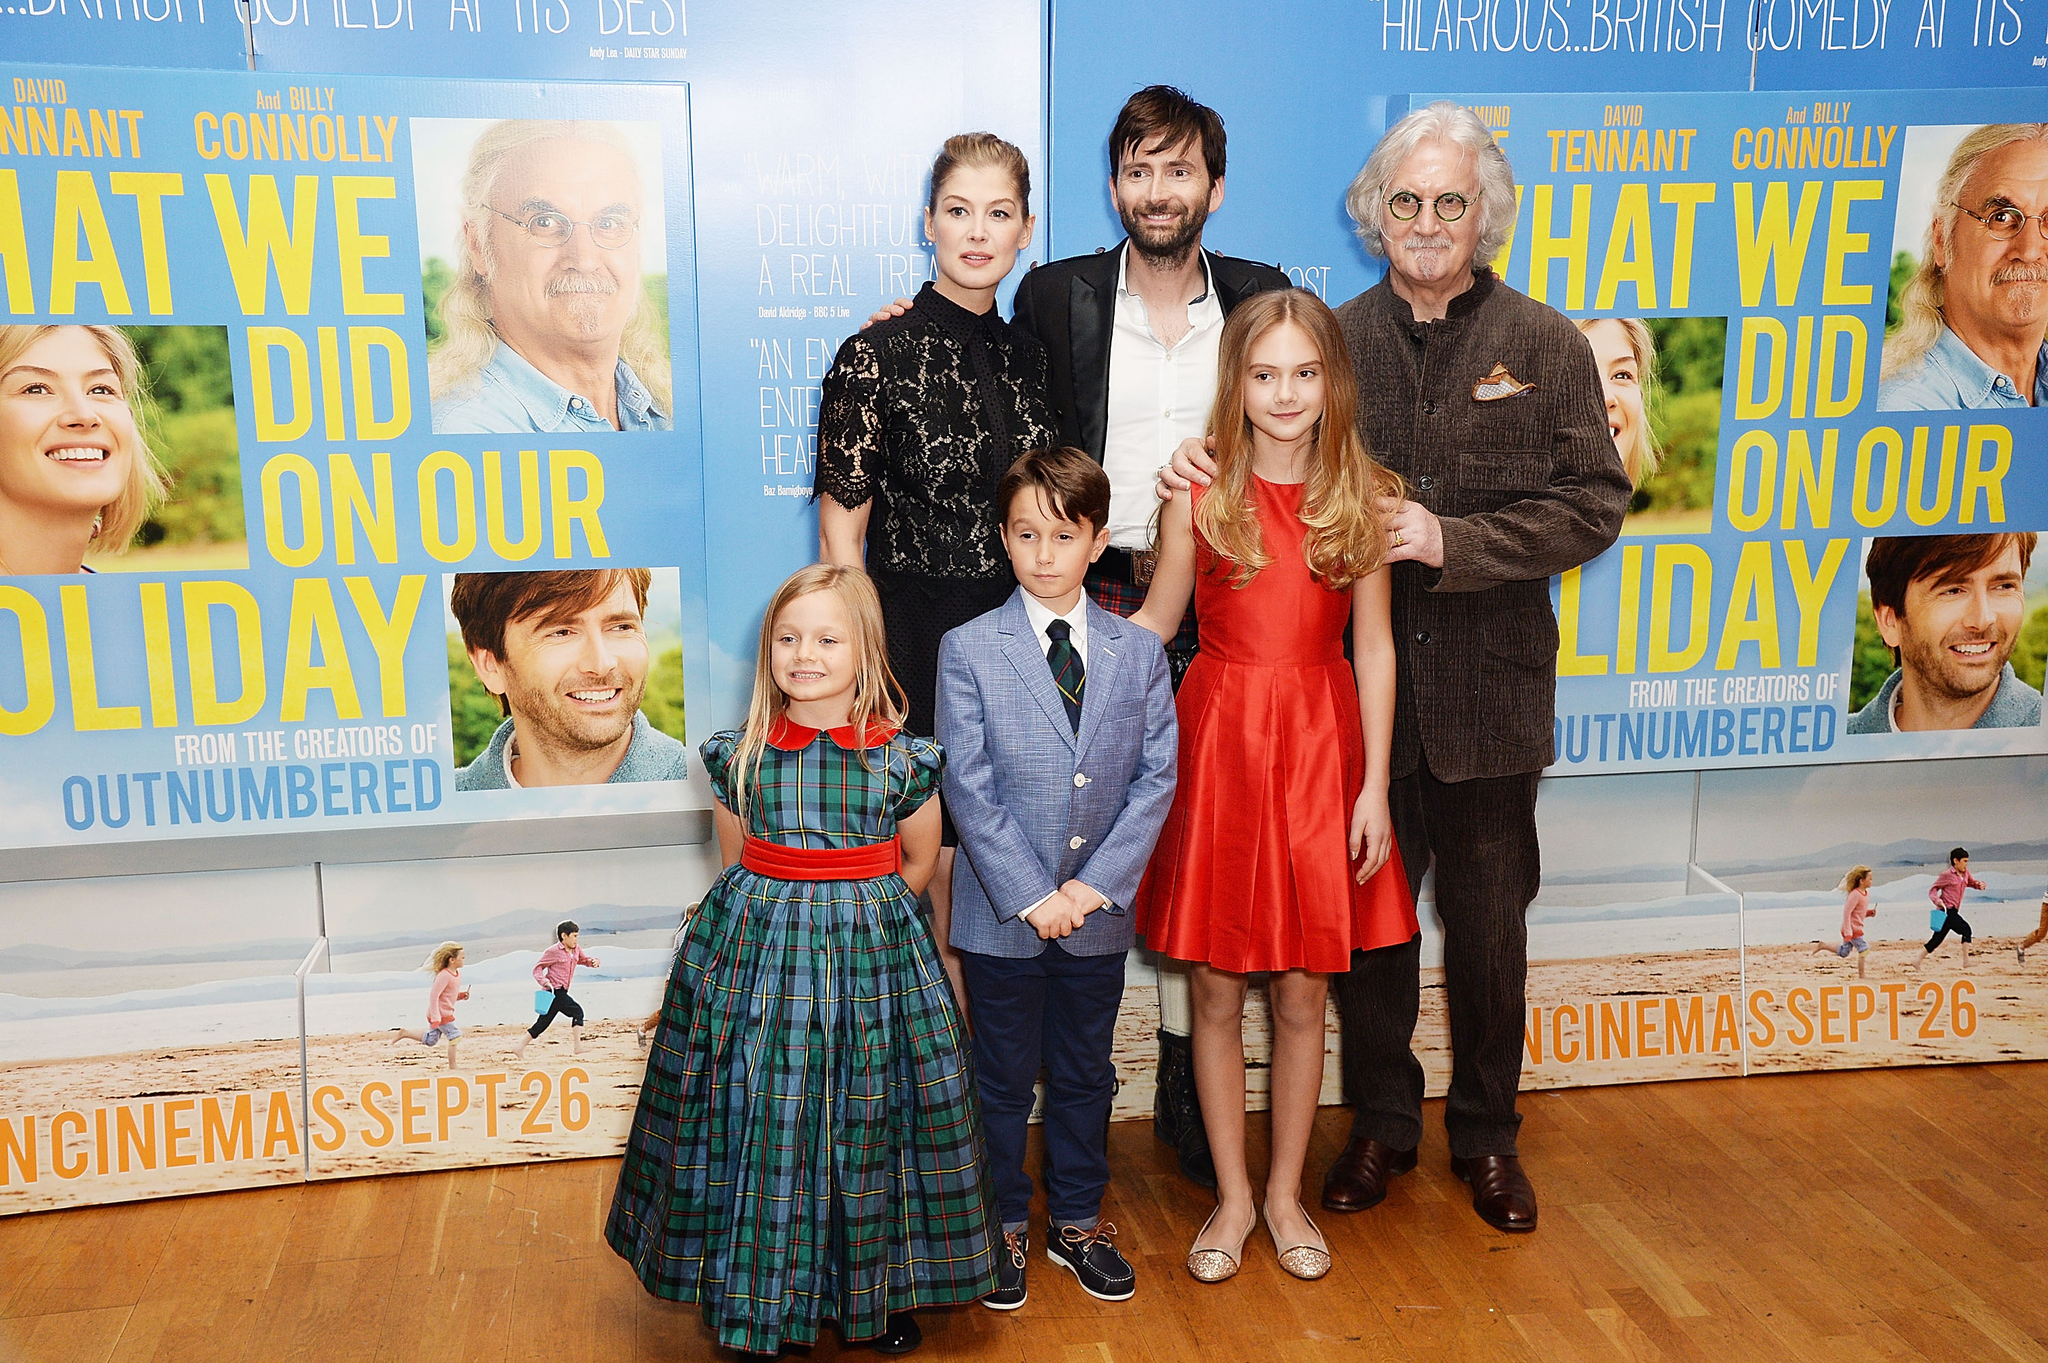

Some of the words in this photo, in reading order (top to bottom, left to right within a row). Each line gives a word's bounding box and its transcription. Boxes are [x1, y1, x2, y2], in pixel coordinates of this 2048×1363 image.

[1746, 0, 1892, 51] COMEDY
[590, 46, 605, 61] Andy
[606, 47, 618, 58] Lea
[624, 47, 642, 59] DAILY
[643, 47, 660, 59] STAR
[660, 48, 688, 59] SUNDAY
[13, 77, 68, 105] DAVID
[256, 89, 281, 110] And
[289, 86, 335, 111] BILLY
[1785, 106, 1807, 125] And
[1812, 101, 1851, 124] BILLY
[194, 111, 399, 163] CONNOLLY
[1603, 104, 1643, 127] DAVID
[1546, 129, 1697, 173] TENNANT
[1731, 124, 1898, 171] CONNOLLY
[203, 174, 405, 316] WE
[1732, 179, 1884, 307] WE
[758, 253, 774, 296] A
[791, 252, 858, 296] REAL
[758, 305, 777, 318] David
[779, 305, 807, 320] Aldridge
[813, 305, 829, 318] BBC
[830, 306, 835, 318] 5
[837, 305, 850, 318] Live
[247, 326, 412, 442] DID
[1734, 314, 1868, 421] DID
[760, 386, 824, 428] ENTE
[763, 484, 776, 496] Baz
[777, 484, 814, 498] Bamigboye
[1727, 428, 1839, 533] ON
[1851, 424, 2014, 529] OUR
[260, 453, 398, 567] ON
[417, 449, 610, 564] OUR
[1629, 680, 1678, 708] FROM
[1683, 677, 1718, 706] THE
[1722, 674, 1810, 704] CREATORS
[1817, 672, 1840, 701] OF
[174, 733, 237, 766] FROM
[243, 730, 288, 763] THE
[294, 725, 402, 760] CREATORS
[411, 723, 438, 755] OF
[62, 758, 443, 832] OUTNUMBERED
[1552, 989, 1776, 1064] CINEMAS
[1786, 982, 1906, 1047] SEPT
[1917, 979, 1978, 1039] 26
[51, 1085, 347, 1180] CINEMAS
[359, 1073, 506, 1148] SEPT
[519, 1067, 591, 1135] 26
